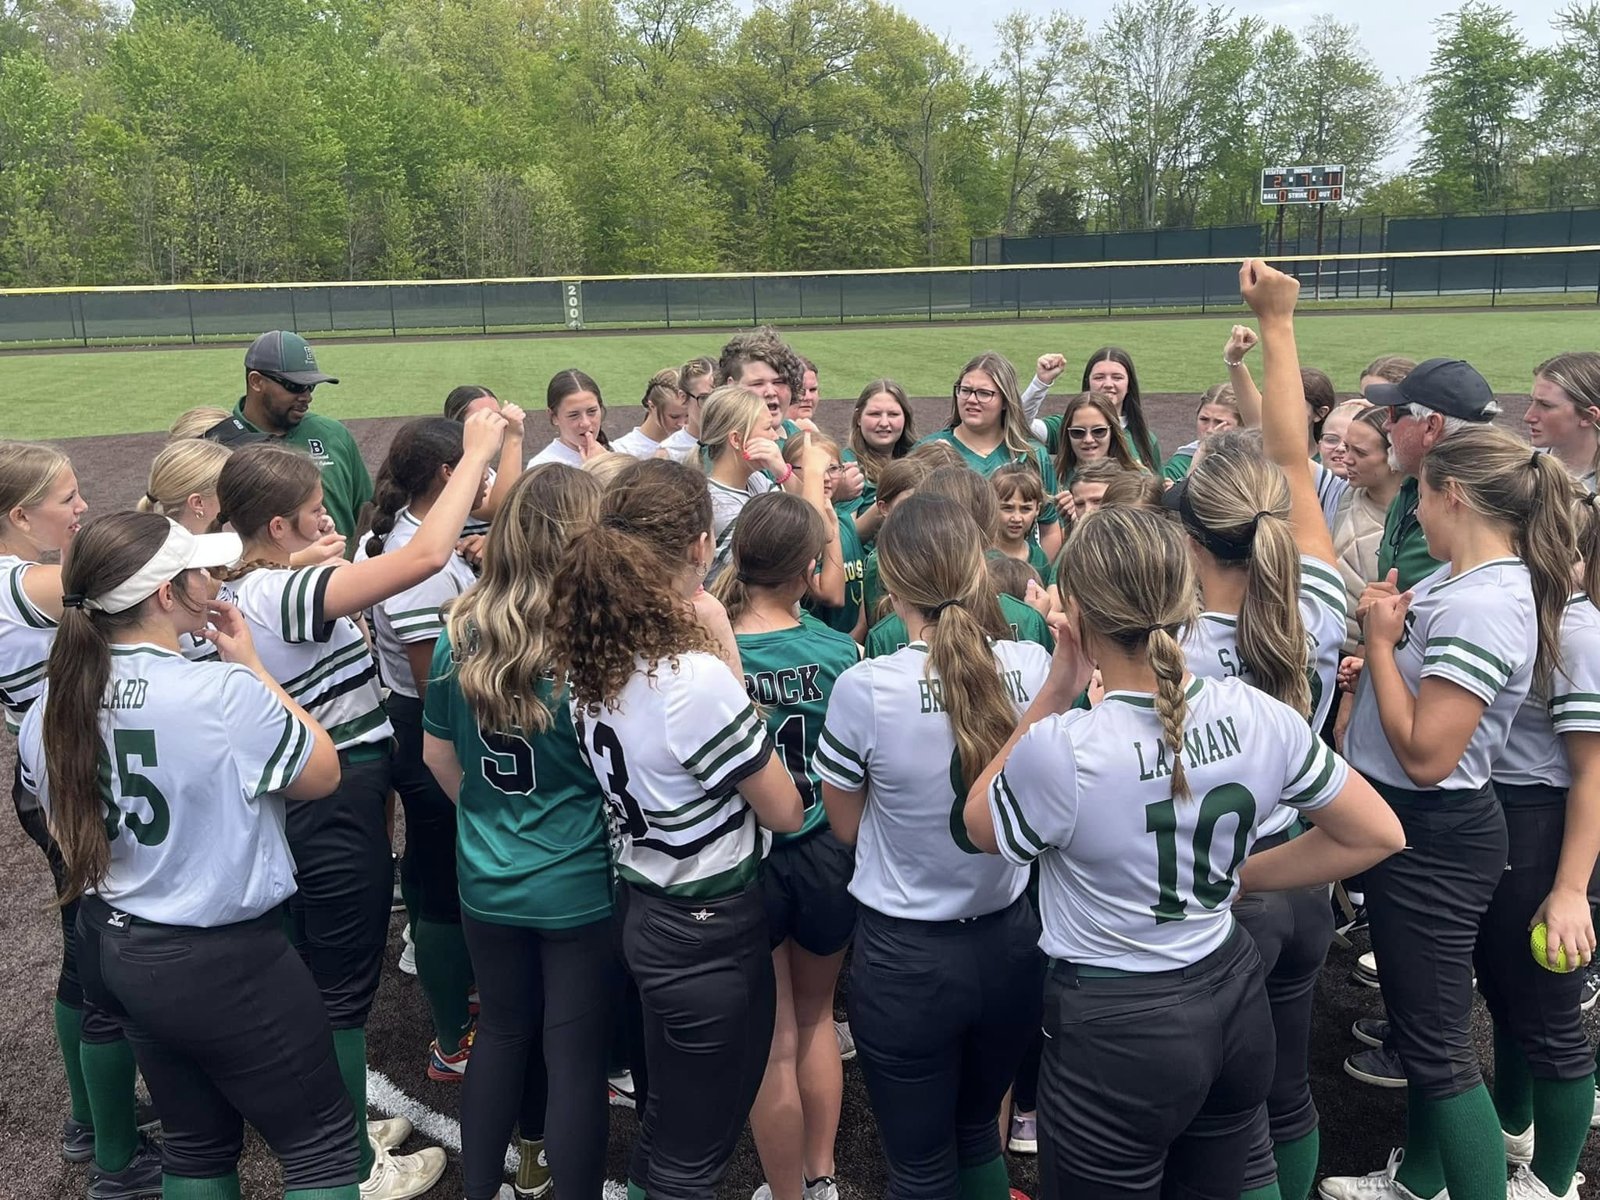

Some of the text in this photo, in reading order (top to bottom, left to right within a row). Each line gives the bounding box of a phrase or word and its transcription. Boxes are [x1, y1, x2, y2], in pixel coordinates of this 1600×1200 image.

[1273, 176, 1282, 188] 2
[1301, 174, 1309, 186] 7
[1279, 190, 1287, 202] 0
[1309, 189, 1317, 201] 0
[567, 285, 579, 319] 200
[308, 439, 325, 456] B
[1133, 715, 1242, 781] LAMAN
[1145, 782, 1257, 926] 10
